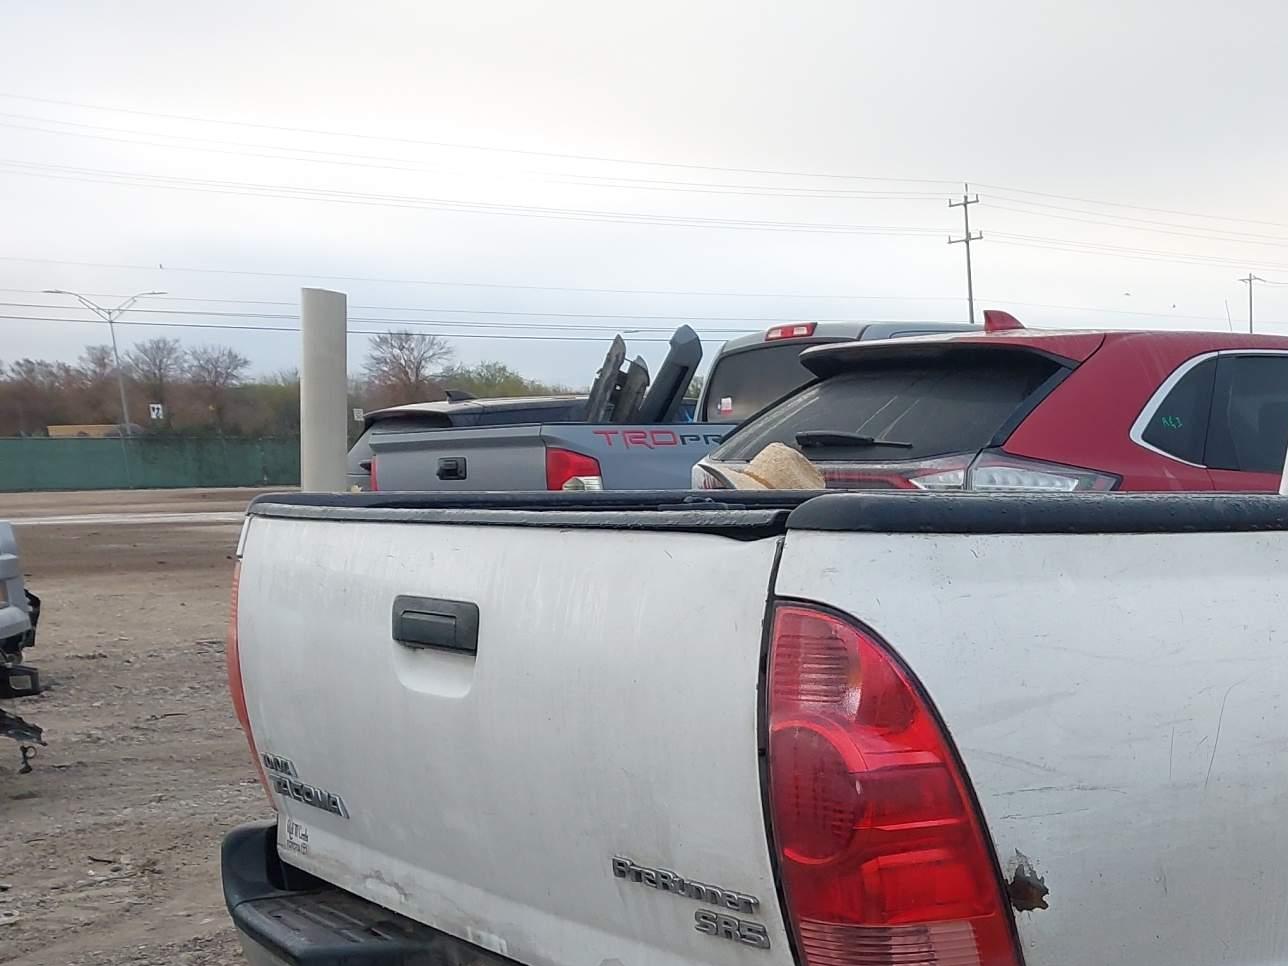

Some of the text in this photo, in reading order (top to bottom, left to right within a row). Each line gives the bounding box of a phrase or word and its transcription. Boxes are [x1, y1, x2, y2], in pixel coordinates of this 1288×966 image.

[592, 430, 678, 450] TRD
[268, 772, 350, 820] TACOMA
[694, 908, 771, 949] SR5
